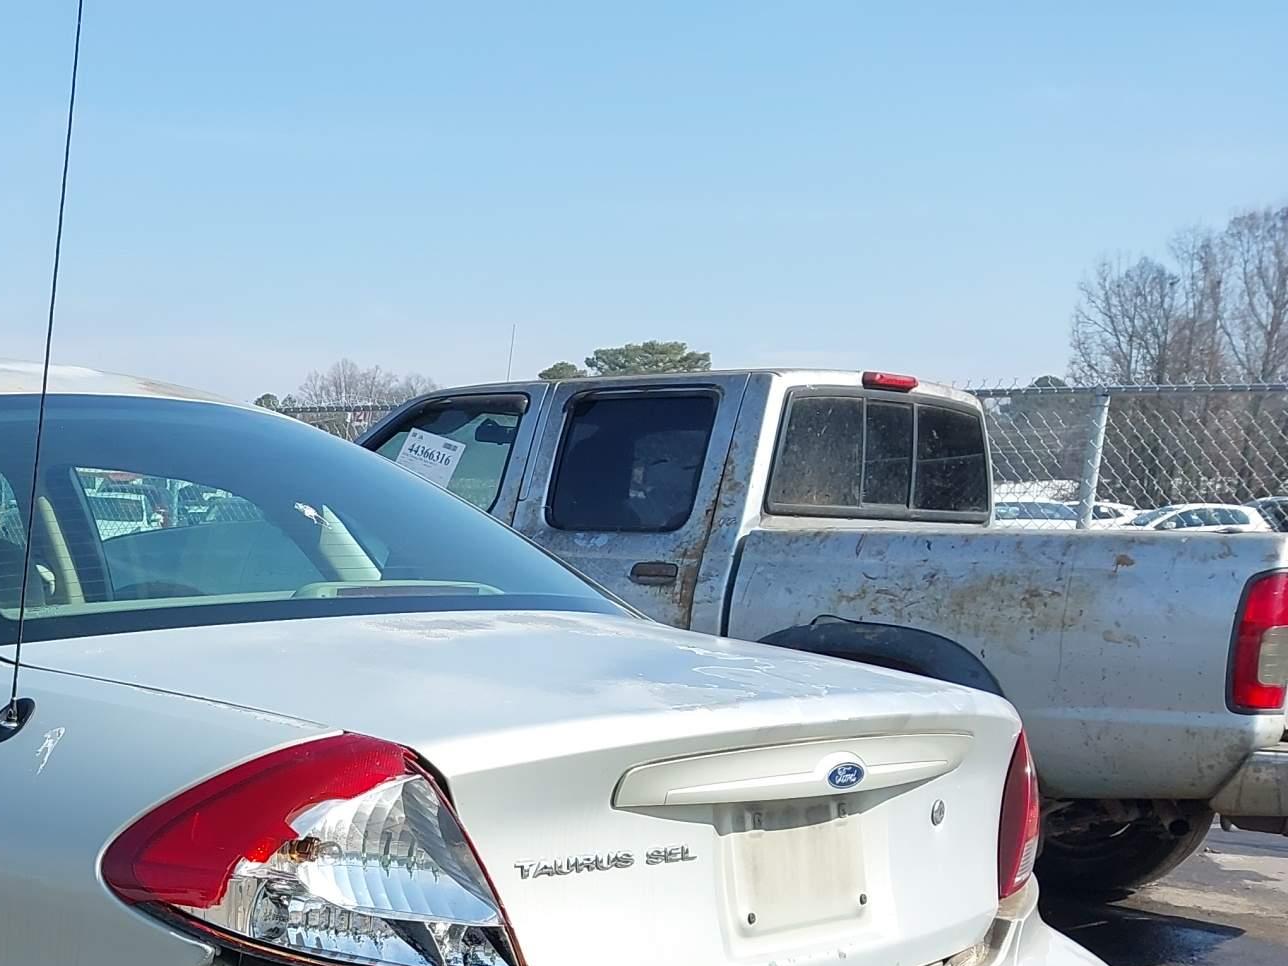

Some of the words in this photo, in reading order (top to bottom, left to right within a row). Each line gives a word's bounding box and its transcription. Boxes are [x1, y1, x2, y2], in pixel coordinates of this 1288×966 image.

[407, 443, 451, 466] 44366316
[514, 850, 635, 880] TAURUS
[645, 843, 698, 866] SEL
